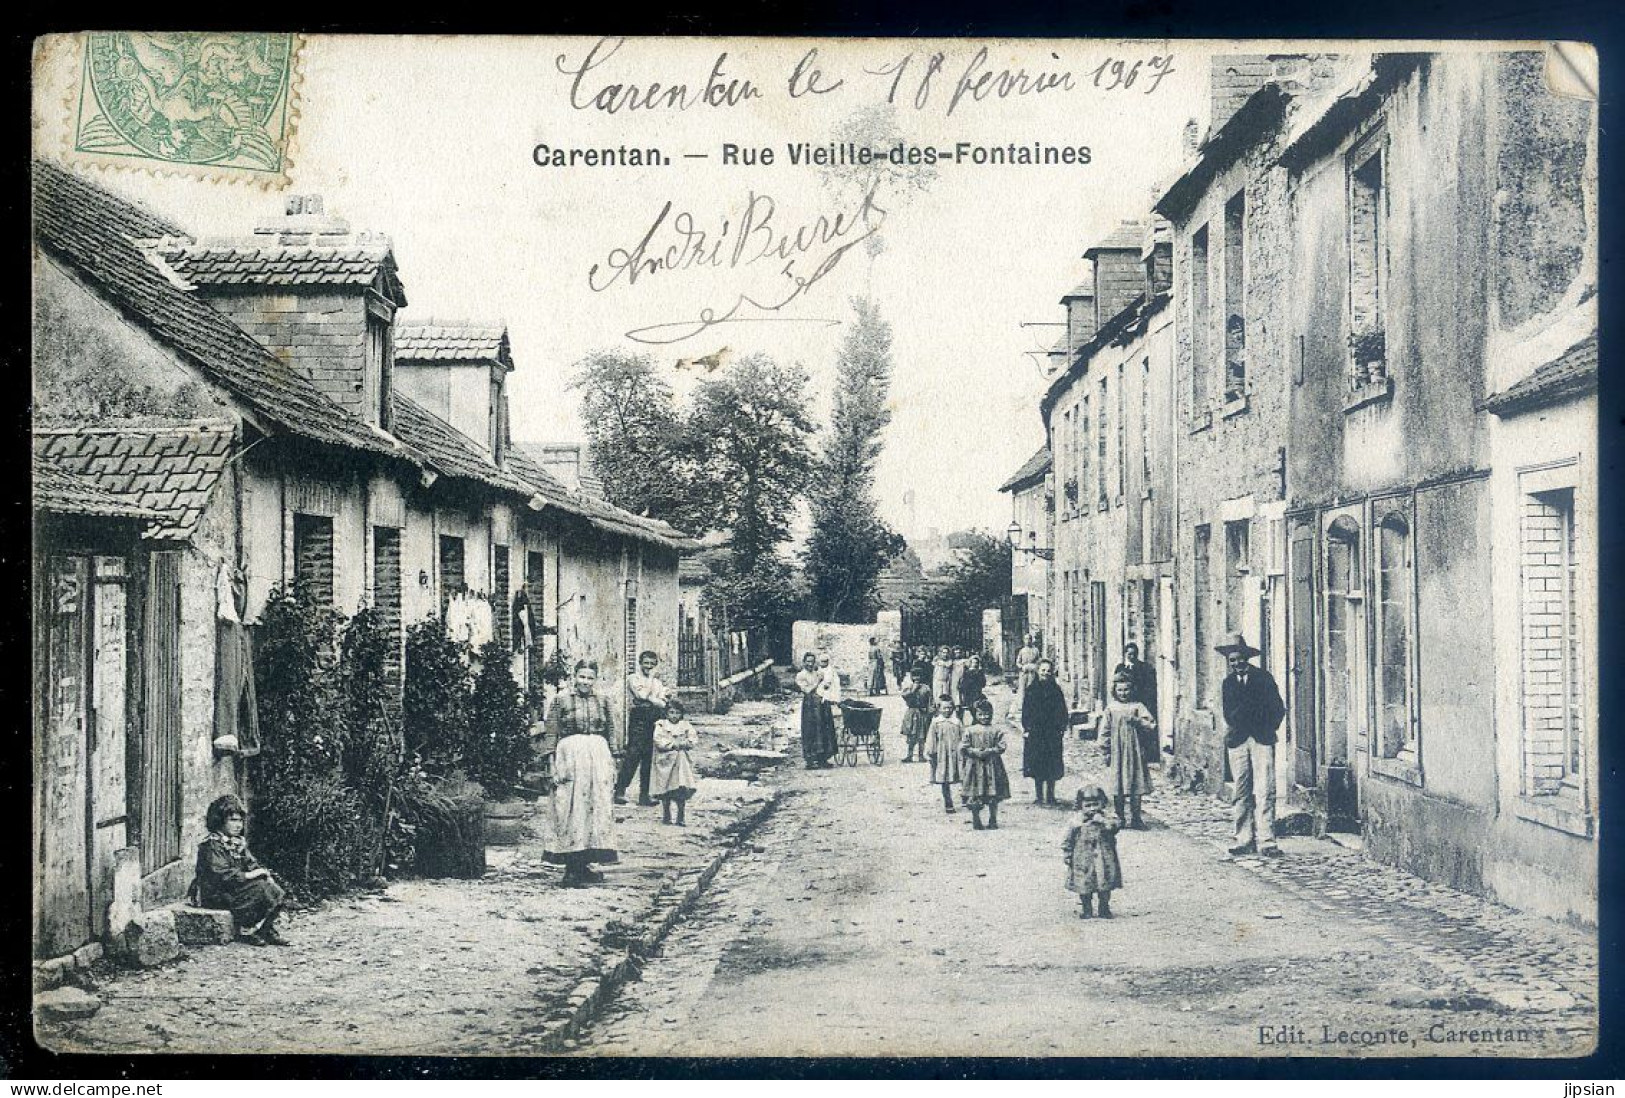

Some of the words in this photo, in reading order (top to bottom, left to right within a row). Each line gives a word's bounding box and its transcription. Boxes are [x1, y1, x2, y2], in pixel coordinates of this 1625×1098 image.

[556, 36, 763, 114] Carentan
[788, 47, 844, 99] le
[862, 52, 947, 110] 18
